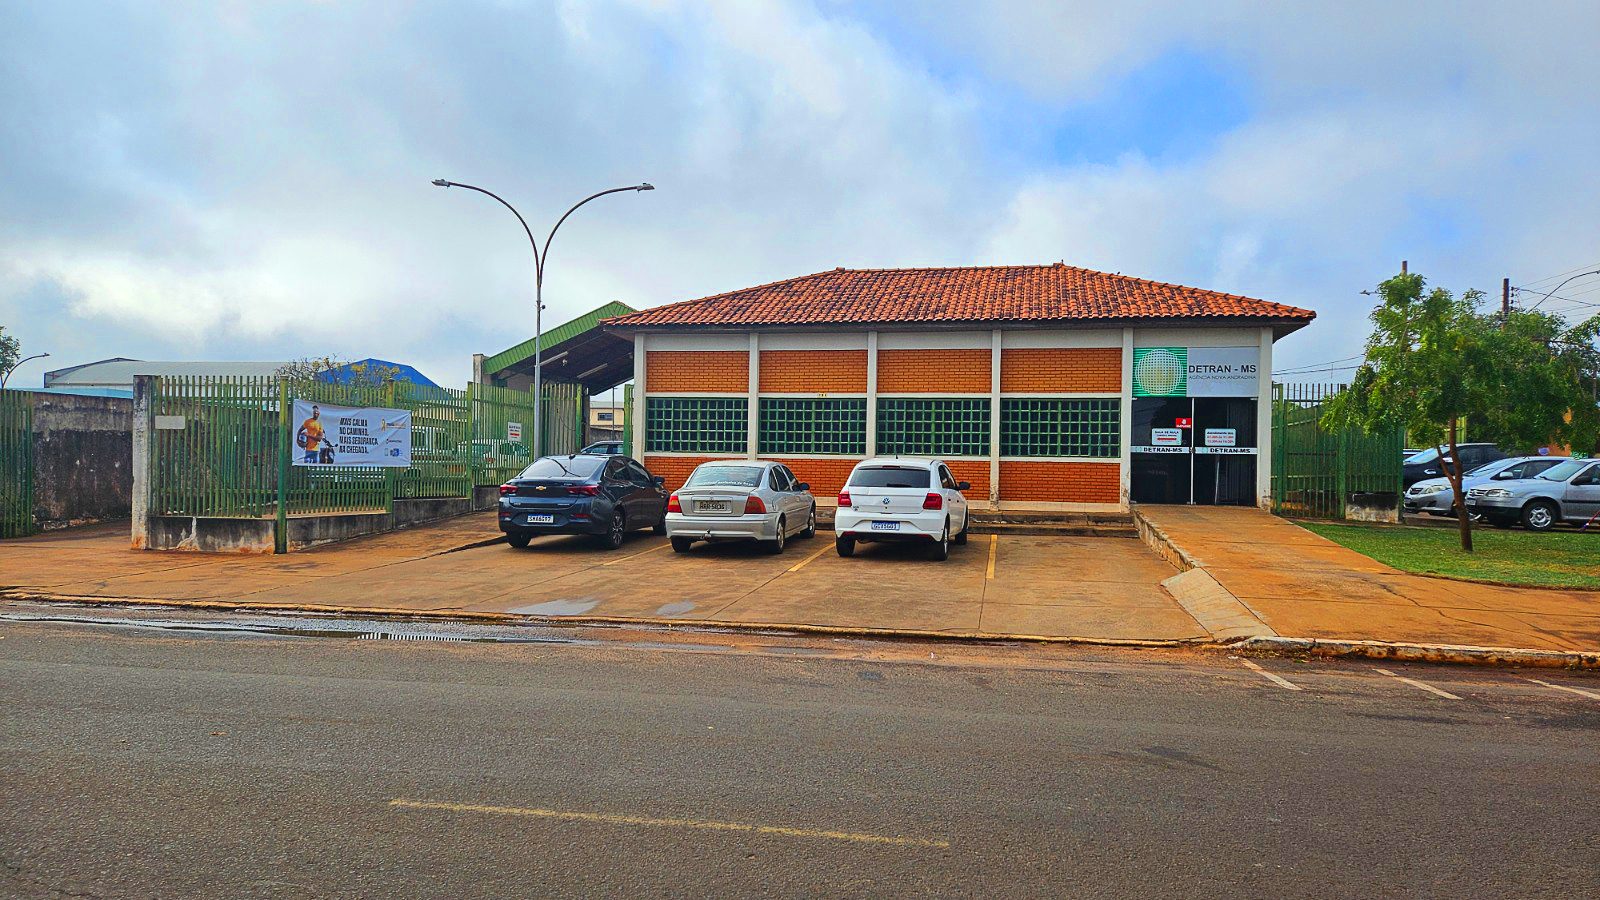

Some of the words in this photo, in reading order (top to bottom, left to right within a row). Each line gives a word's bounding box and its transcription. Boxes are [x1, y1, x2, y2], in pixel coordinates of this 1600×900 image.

[1188, 364, 1231, 373] DETRAN
[1241, 364, 1256, 373] MS
[340, 417, 352, 426] MAIS
[352, 418, 367, 427] CALMA
[339, 427, 346, 435] NO
[339, 436, 351, 444] MAIS
